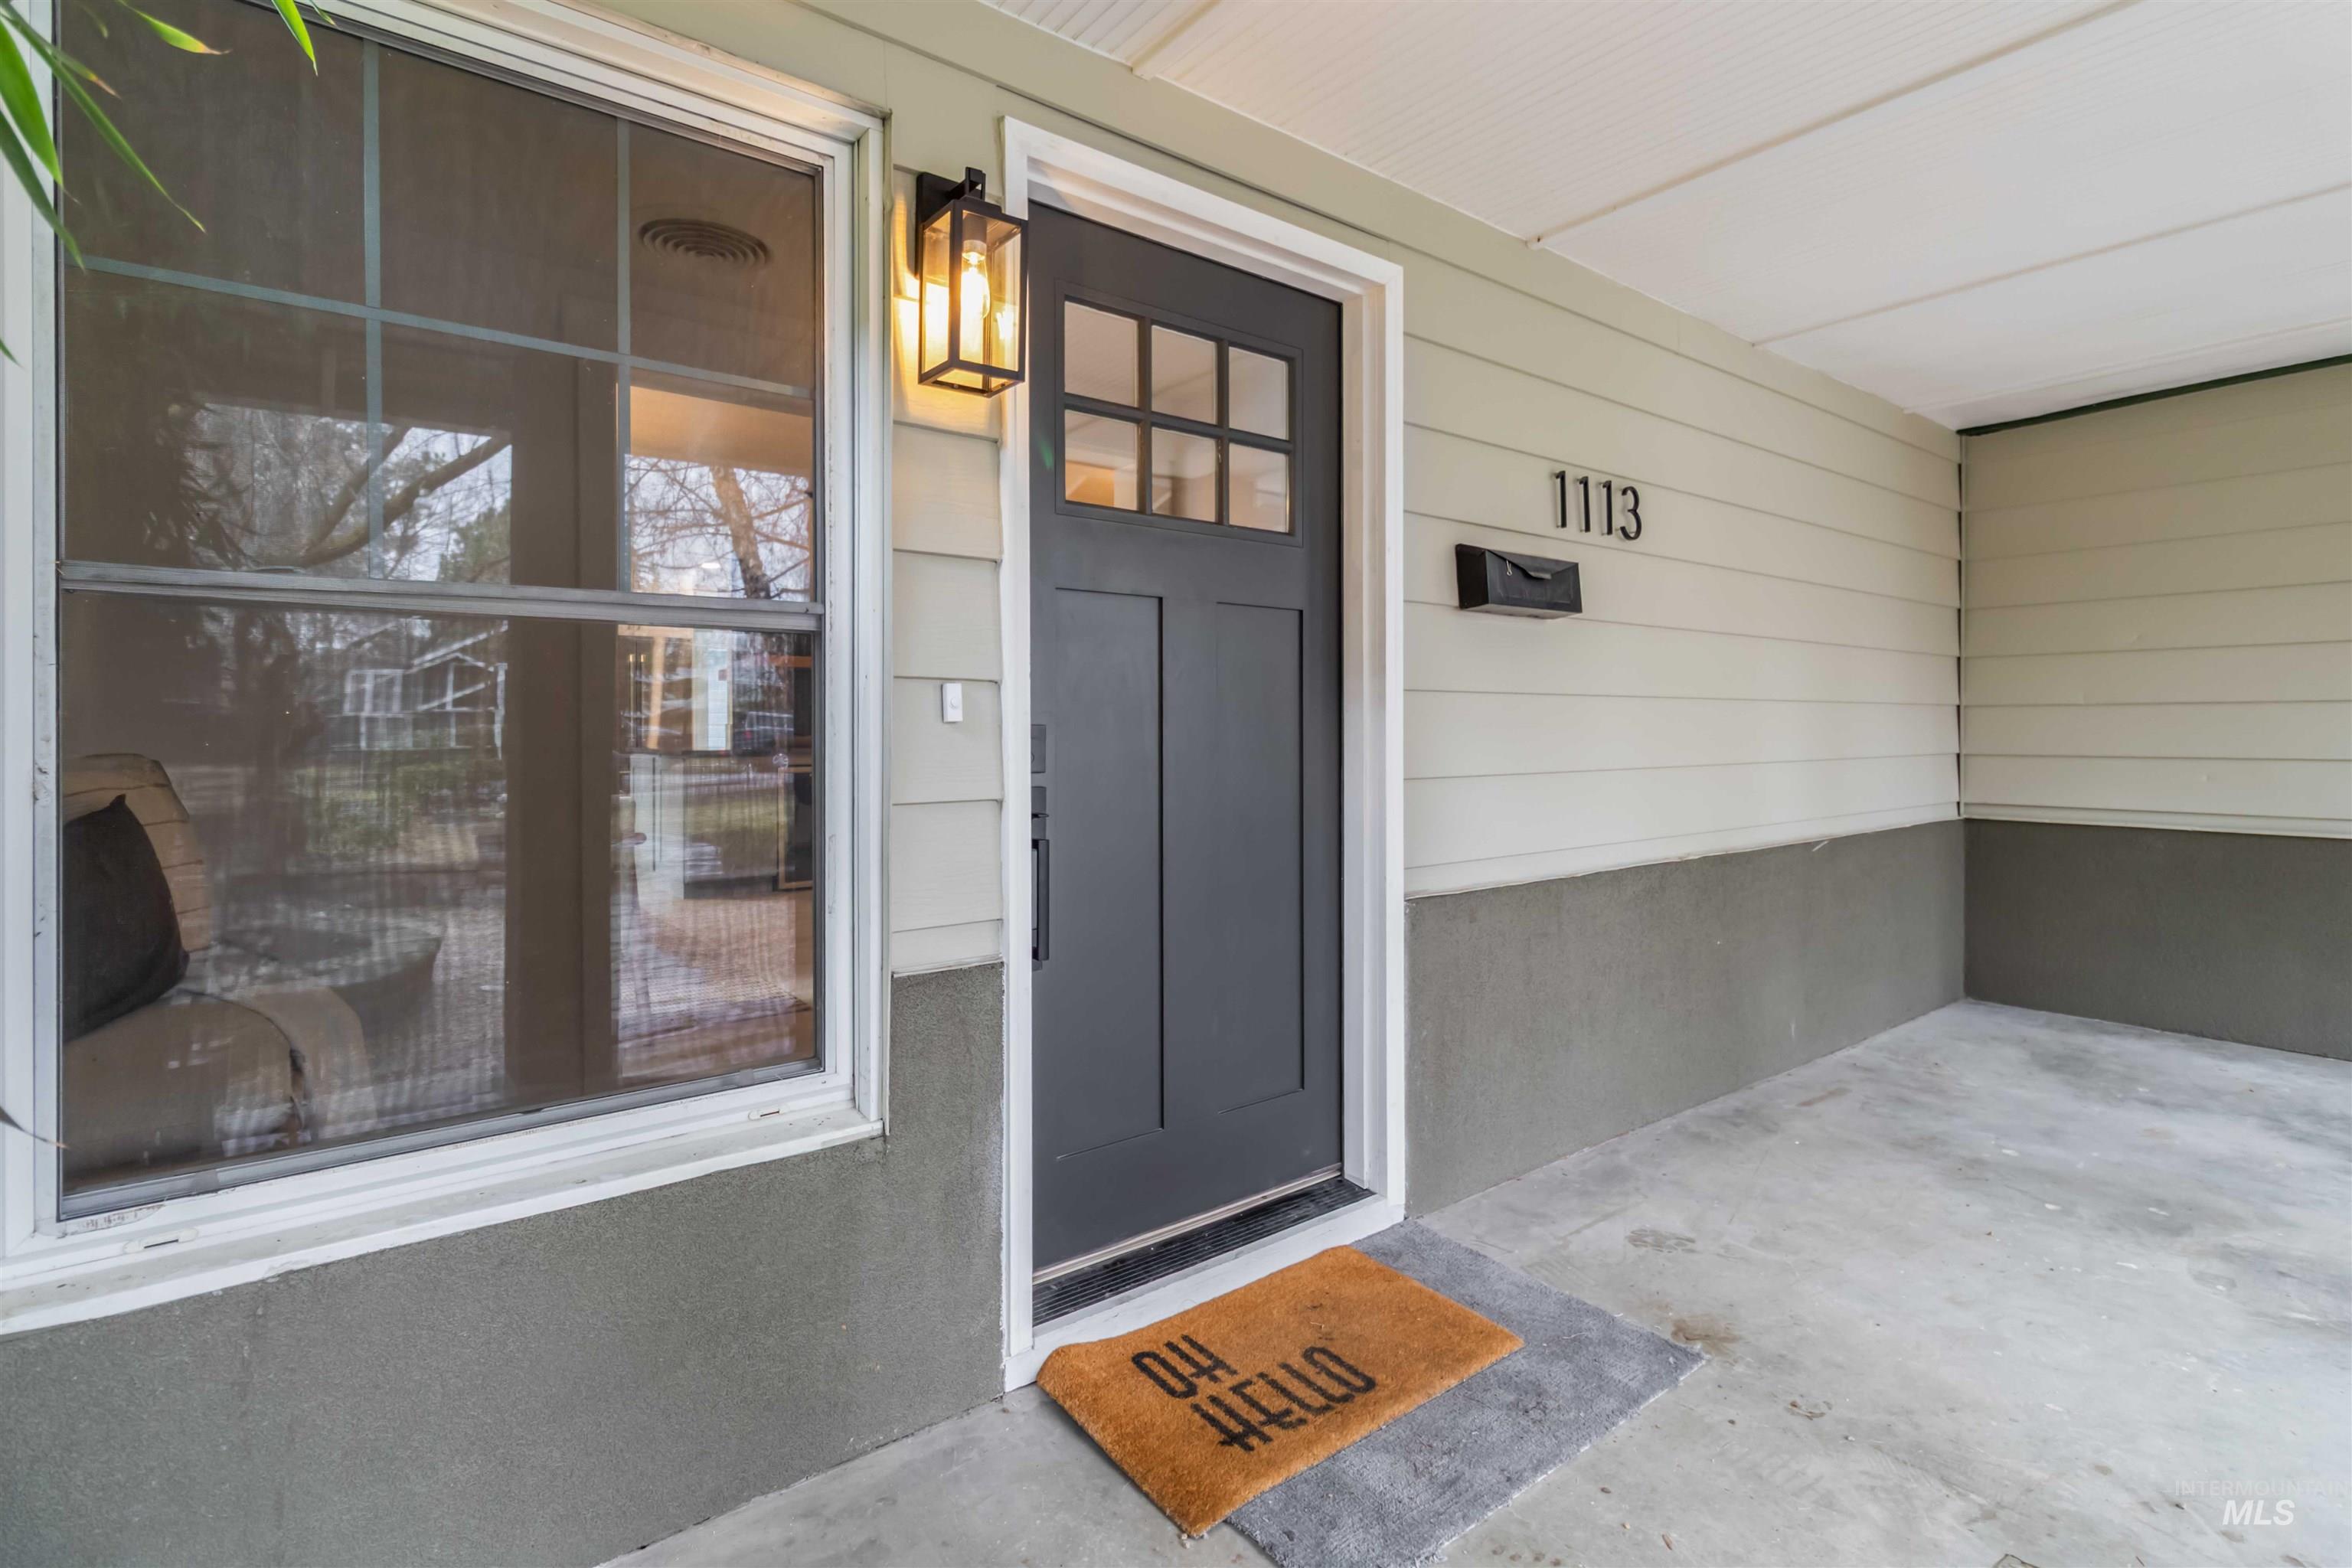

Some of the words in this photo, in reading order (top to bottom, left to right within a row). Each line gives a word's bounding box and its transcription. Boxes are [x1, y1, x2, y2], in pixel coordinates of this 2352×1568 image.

[1555, 470, 1642, 541] 1113
[1132, 1334, 1238, 1400] OH
[1191, 1346, 1376, 1452] HELLO
